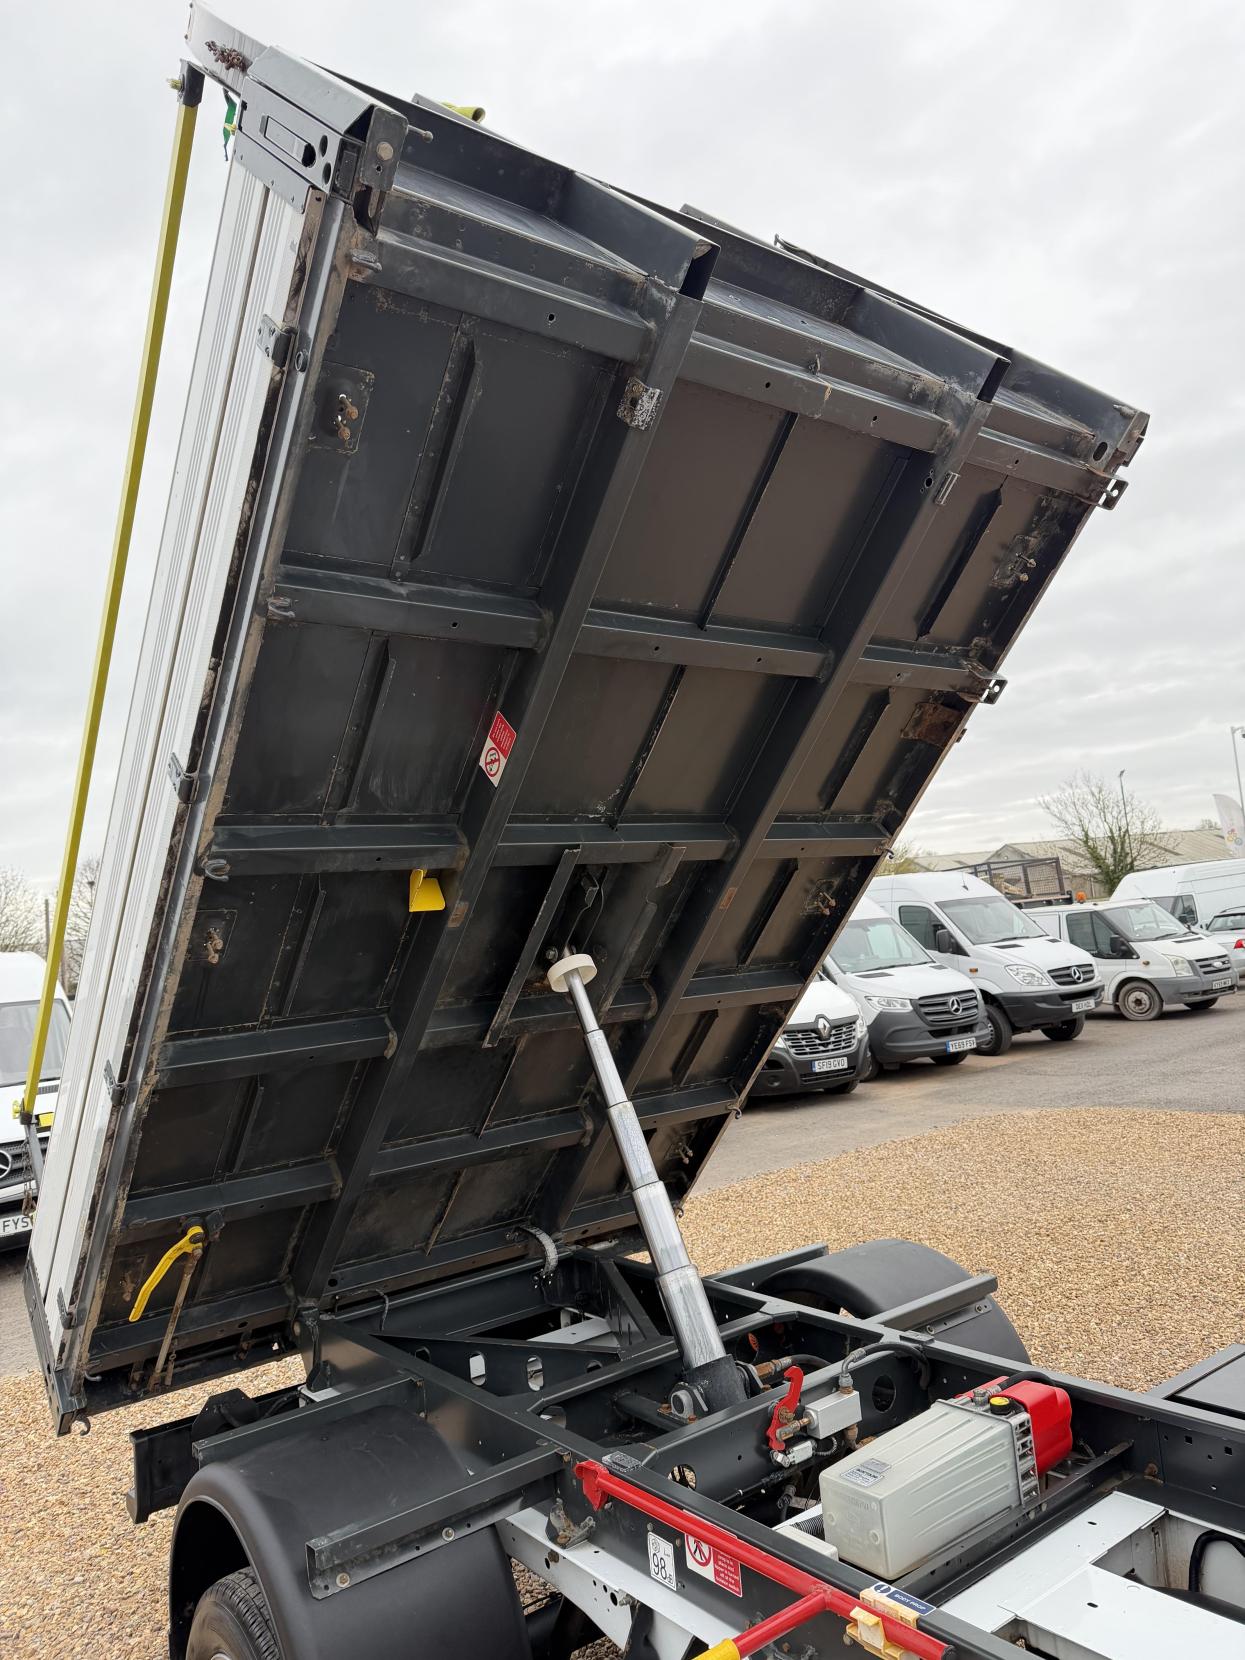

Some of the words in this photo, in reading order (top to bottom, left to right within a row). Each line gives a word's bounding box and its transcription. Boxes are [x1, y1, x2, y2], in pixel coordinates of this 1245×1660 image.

[817, 1060, 832, 1070] SF19
[2, 1216, 29, 1232] FYS
[653, 1553, 667, 1580] 98
